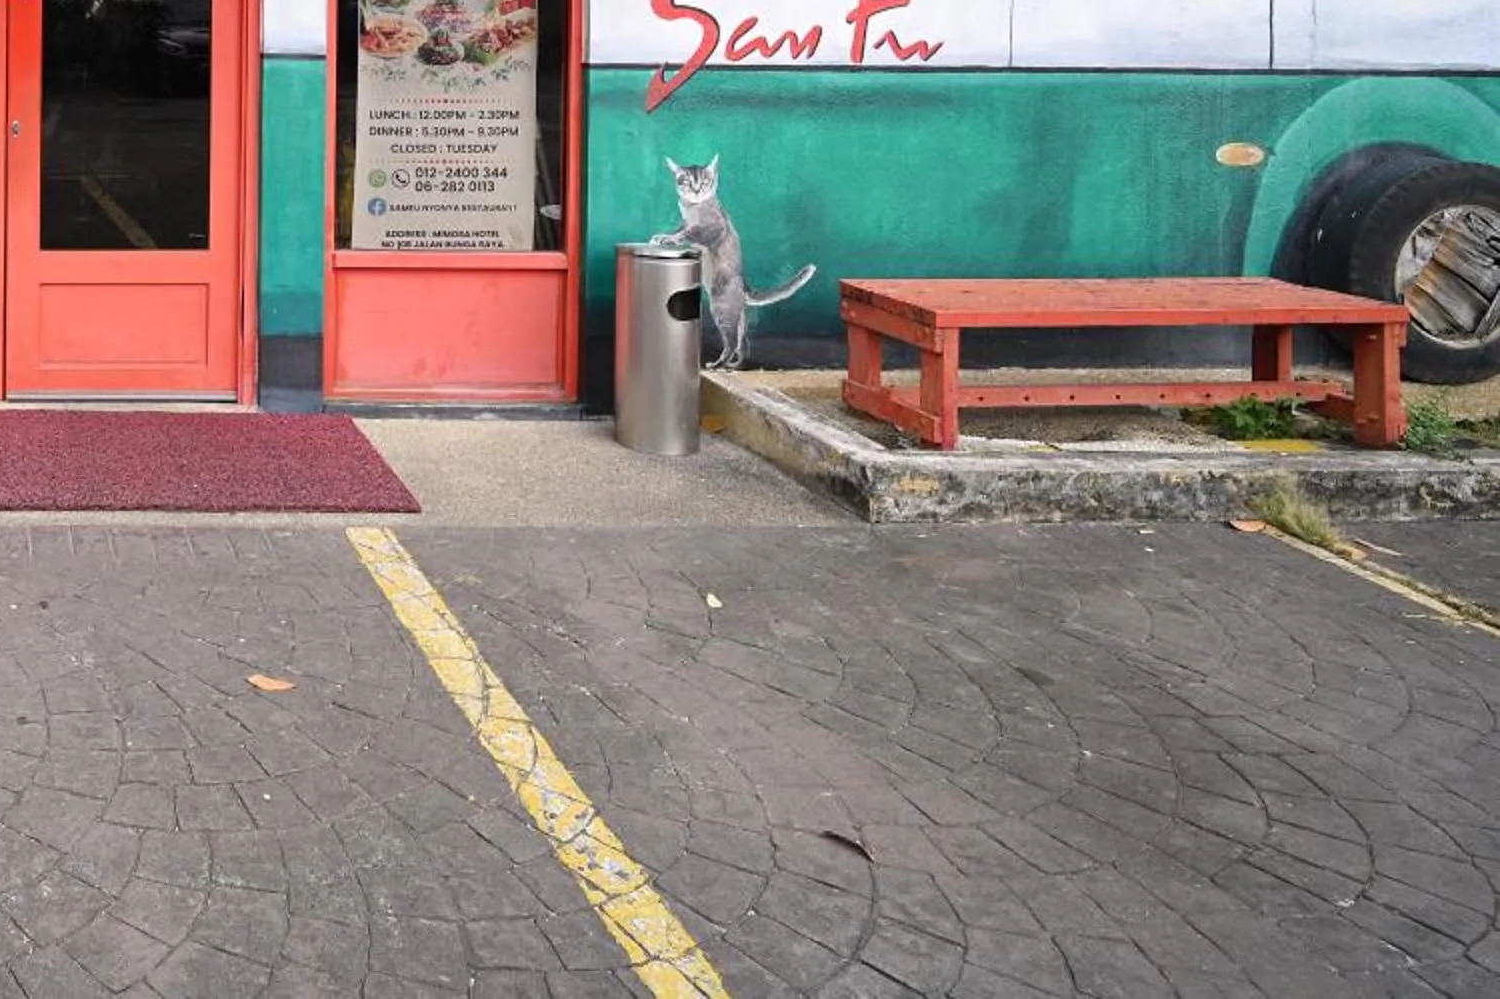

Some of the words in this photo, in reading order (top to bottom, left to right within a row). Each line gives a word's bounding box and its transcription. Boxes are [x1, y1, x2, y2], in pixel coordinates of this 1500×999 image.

[369, 110, 409, 120] LUNCH
[369, 126, 413, 137] DINNER
[390, 144, 437, 154] CLOSED
[446, 144, 498, 154] TUESDAY
[415, 167, 479, 178] 012-2400
[483, 166, 508, 178] 344
[415, 181, 465, 192] 06-282
[468, 180, 495, 192] 0113
